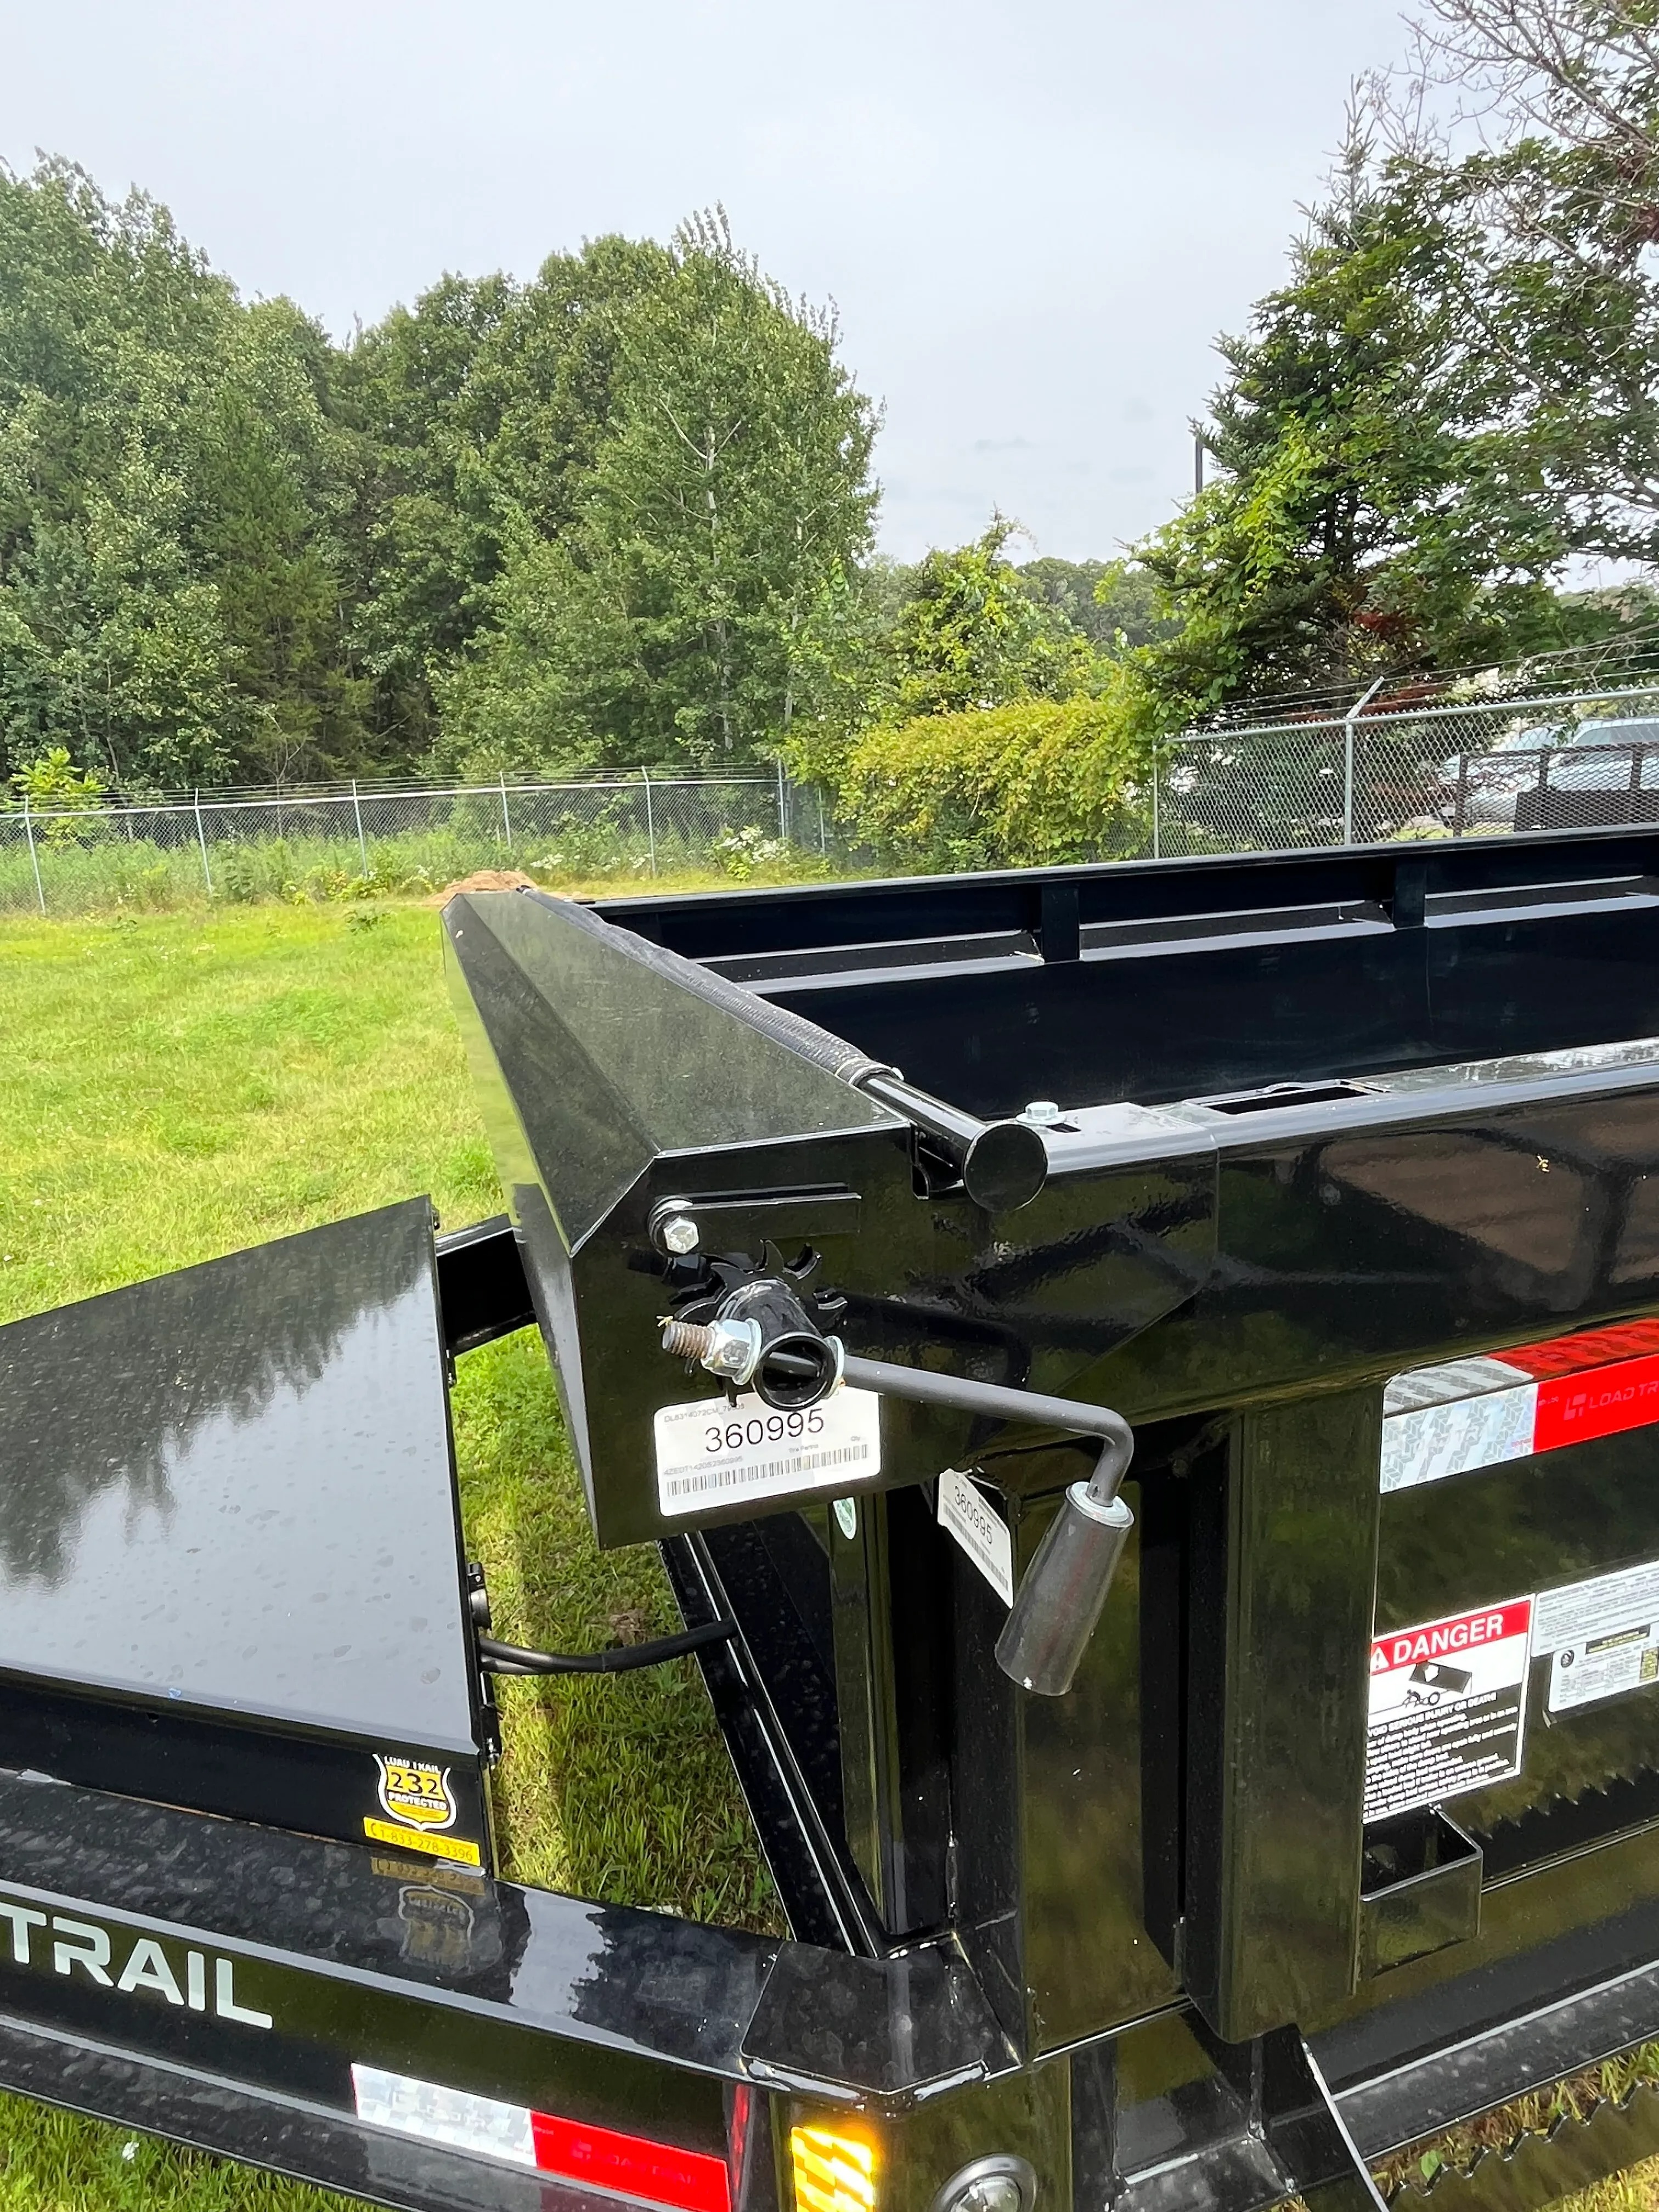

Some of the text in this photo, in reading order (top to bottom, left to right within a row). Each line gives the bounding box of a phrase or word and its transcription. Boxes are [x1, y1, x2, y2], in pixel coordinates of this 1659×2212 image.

[1589, 1386, 1635, 1409] LOAD
[705, 1408, 825, 1452] 360995
[954, 1485, 993, 1545] 360995
[1393, 1613, 1504, 1665] DANGER
[1425, 1706, 1454, 1720] INJURY
[1454, 1702, 1467, 1712] OR
[391, 1771, 439, 1796] 232
[388, 1791, 448, 1811] PROTECTED
[381, 1829, 473, 1862] 1-833-278-3396
[0, 1902, 273, 2030] TRAIL
